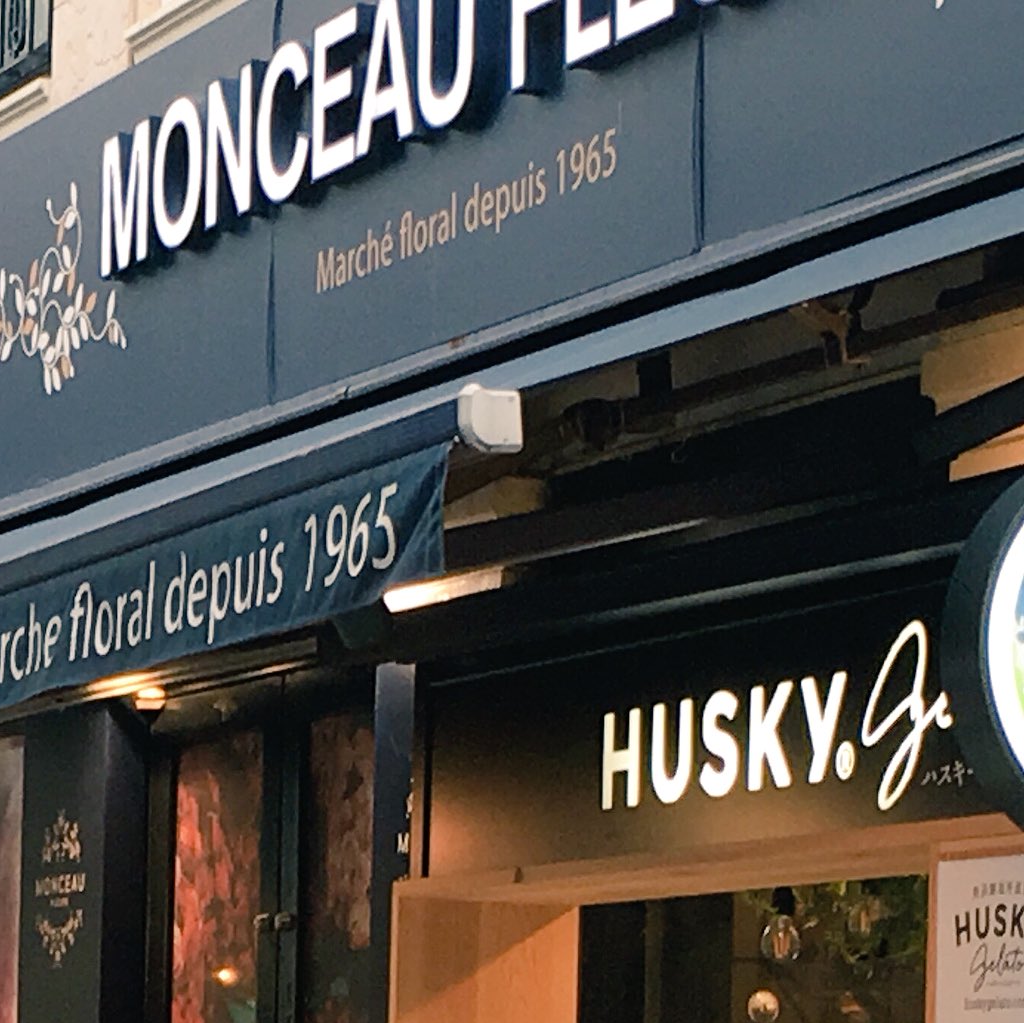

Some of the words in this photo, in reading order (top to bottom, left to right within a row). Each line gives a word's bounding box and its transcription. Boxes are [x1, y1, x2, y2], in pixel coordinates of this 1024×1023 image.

[100, 0, 474, 279] MONCEAU
[316, 220, 394, 294] Marché
[399, 192, 458, 260] floral
[464, 161, 547, 234] depuis
[555, 127, 618, 196] 1965
[68, 560, 156, 662] floral
[163, 528, 285, 645] depuis
[304, 482, 399, 592] 1965
